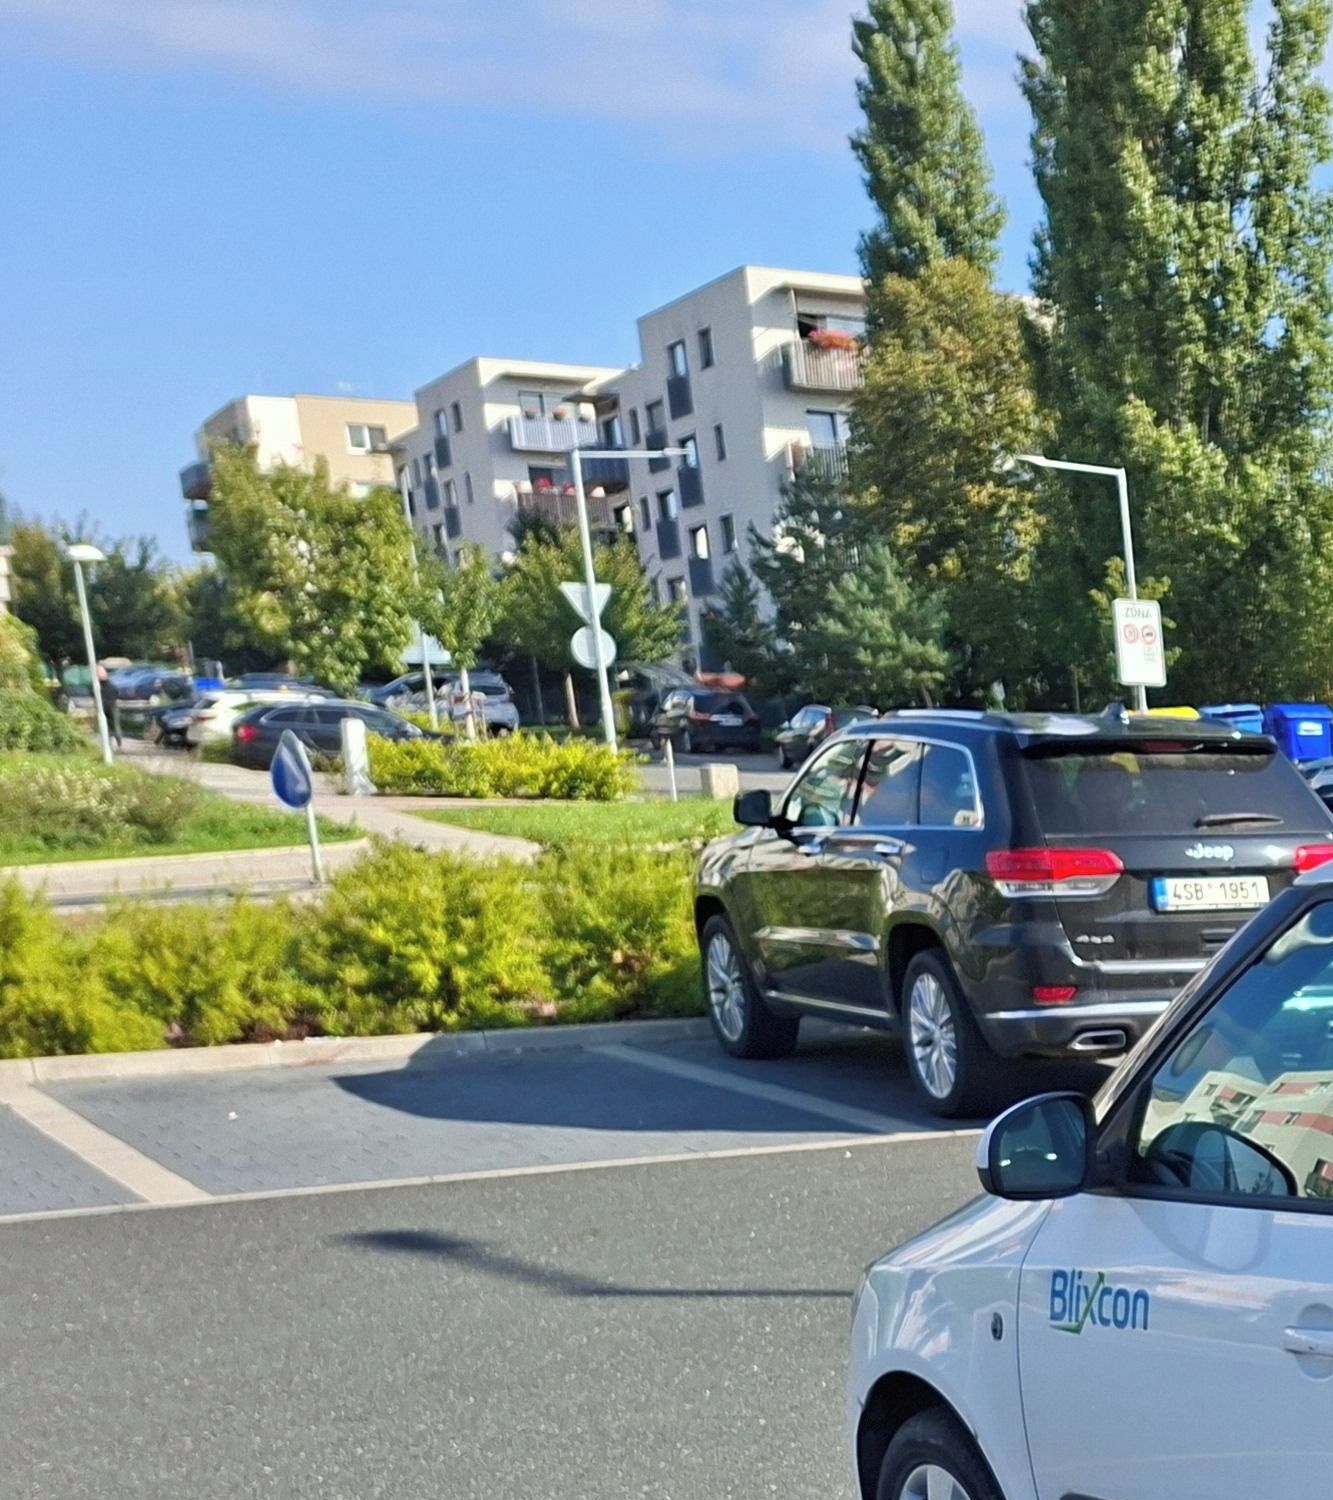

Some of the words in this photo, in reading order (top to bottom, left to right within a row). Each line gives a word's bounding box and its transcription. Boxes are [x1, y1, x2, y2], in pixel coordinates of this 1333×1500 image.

[1187, 843, 1234, 861] Jeep
[1172, 880, 1204, 901] 4SB
[1219, 880, 1260, 901] 1951
[1049, 1268, 1150, 1335] Blixcon
